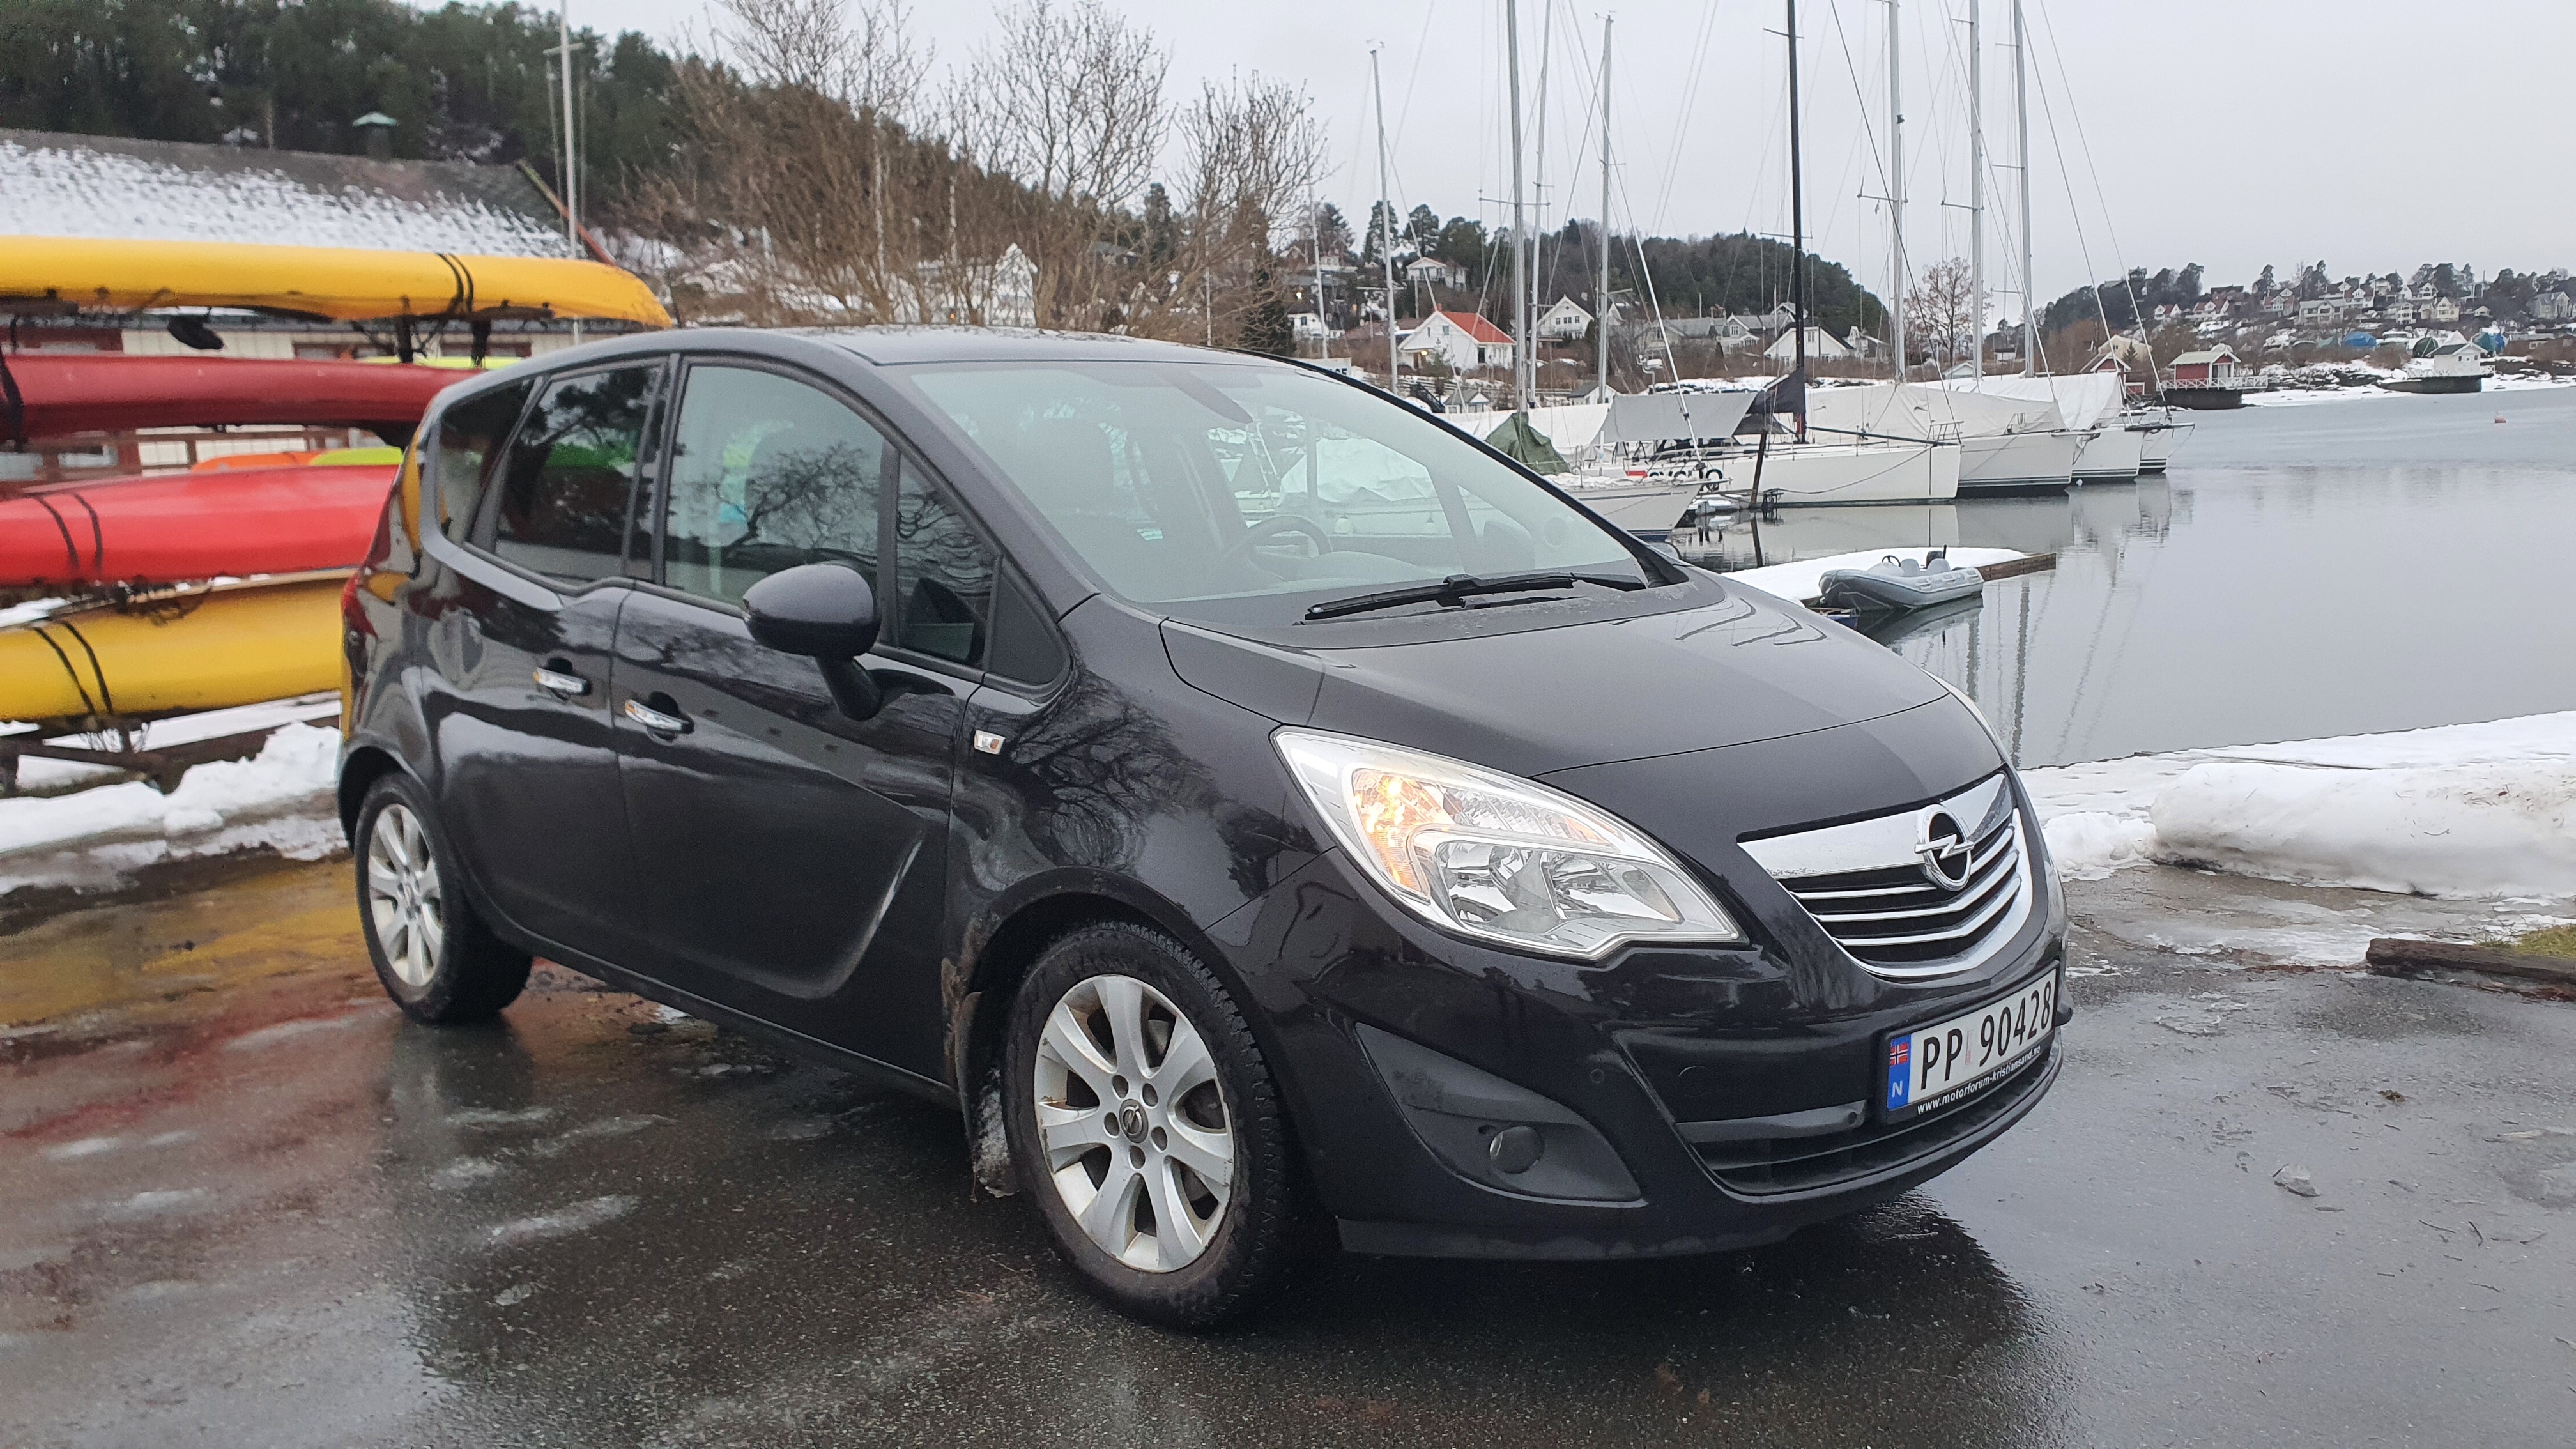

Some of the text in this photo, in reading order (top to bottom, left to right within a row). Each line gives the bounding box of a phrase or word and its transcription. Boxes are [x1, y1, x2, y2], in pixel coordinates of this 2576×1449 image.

[1920, 981, 2051, 1090] PP 90428
[1892, 1080, 1903, 1098] N
[1917, 1045, 2041, 1114] www.motorforum-kristiansand.no
